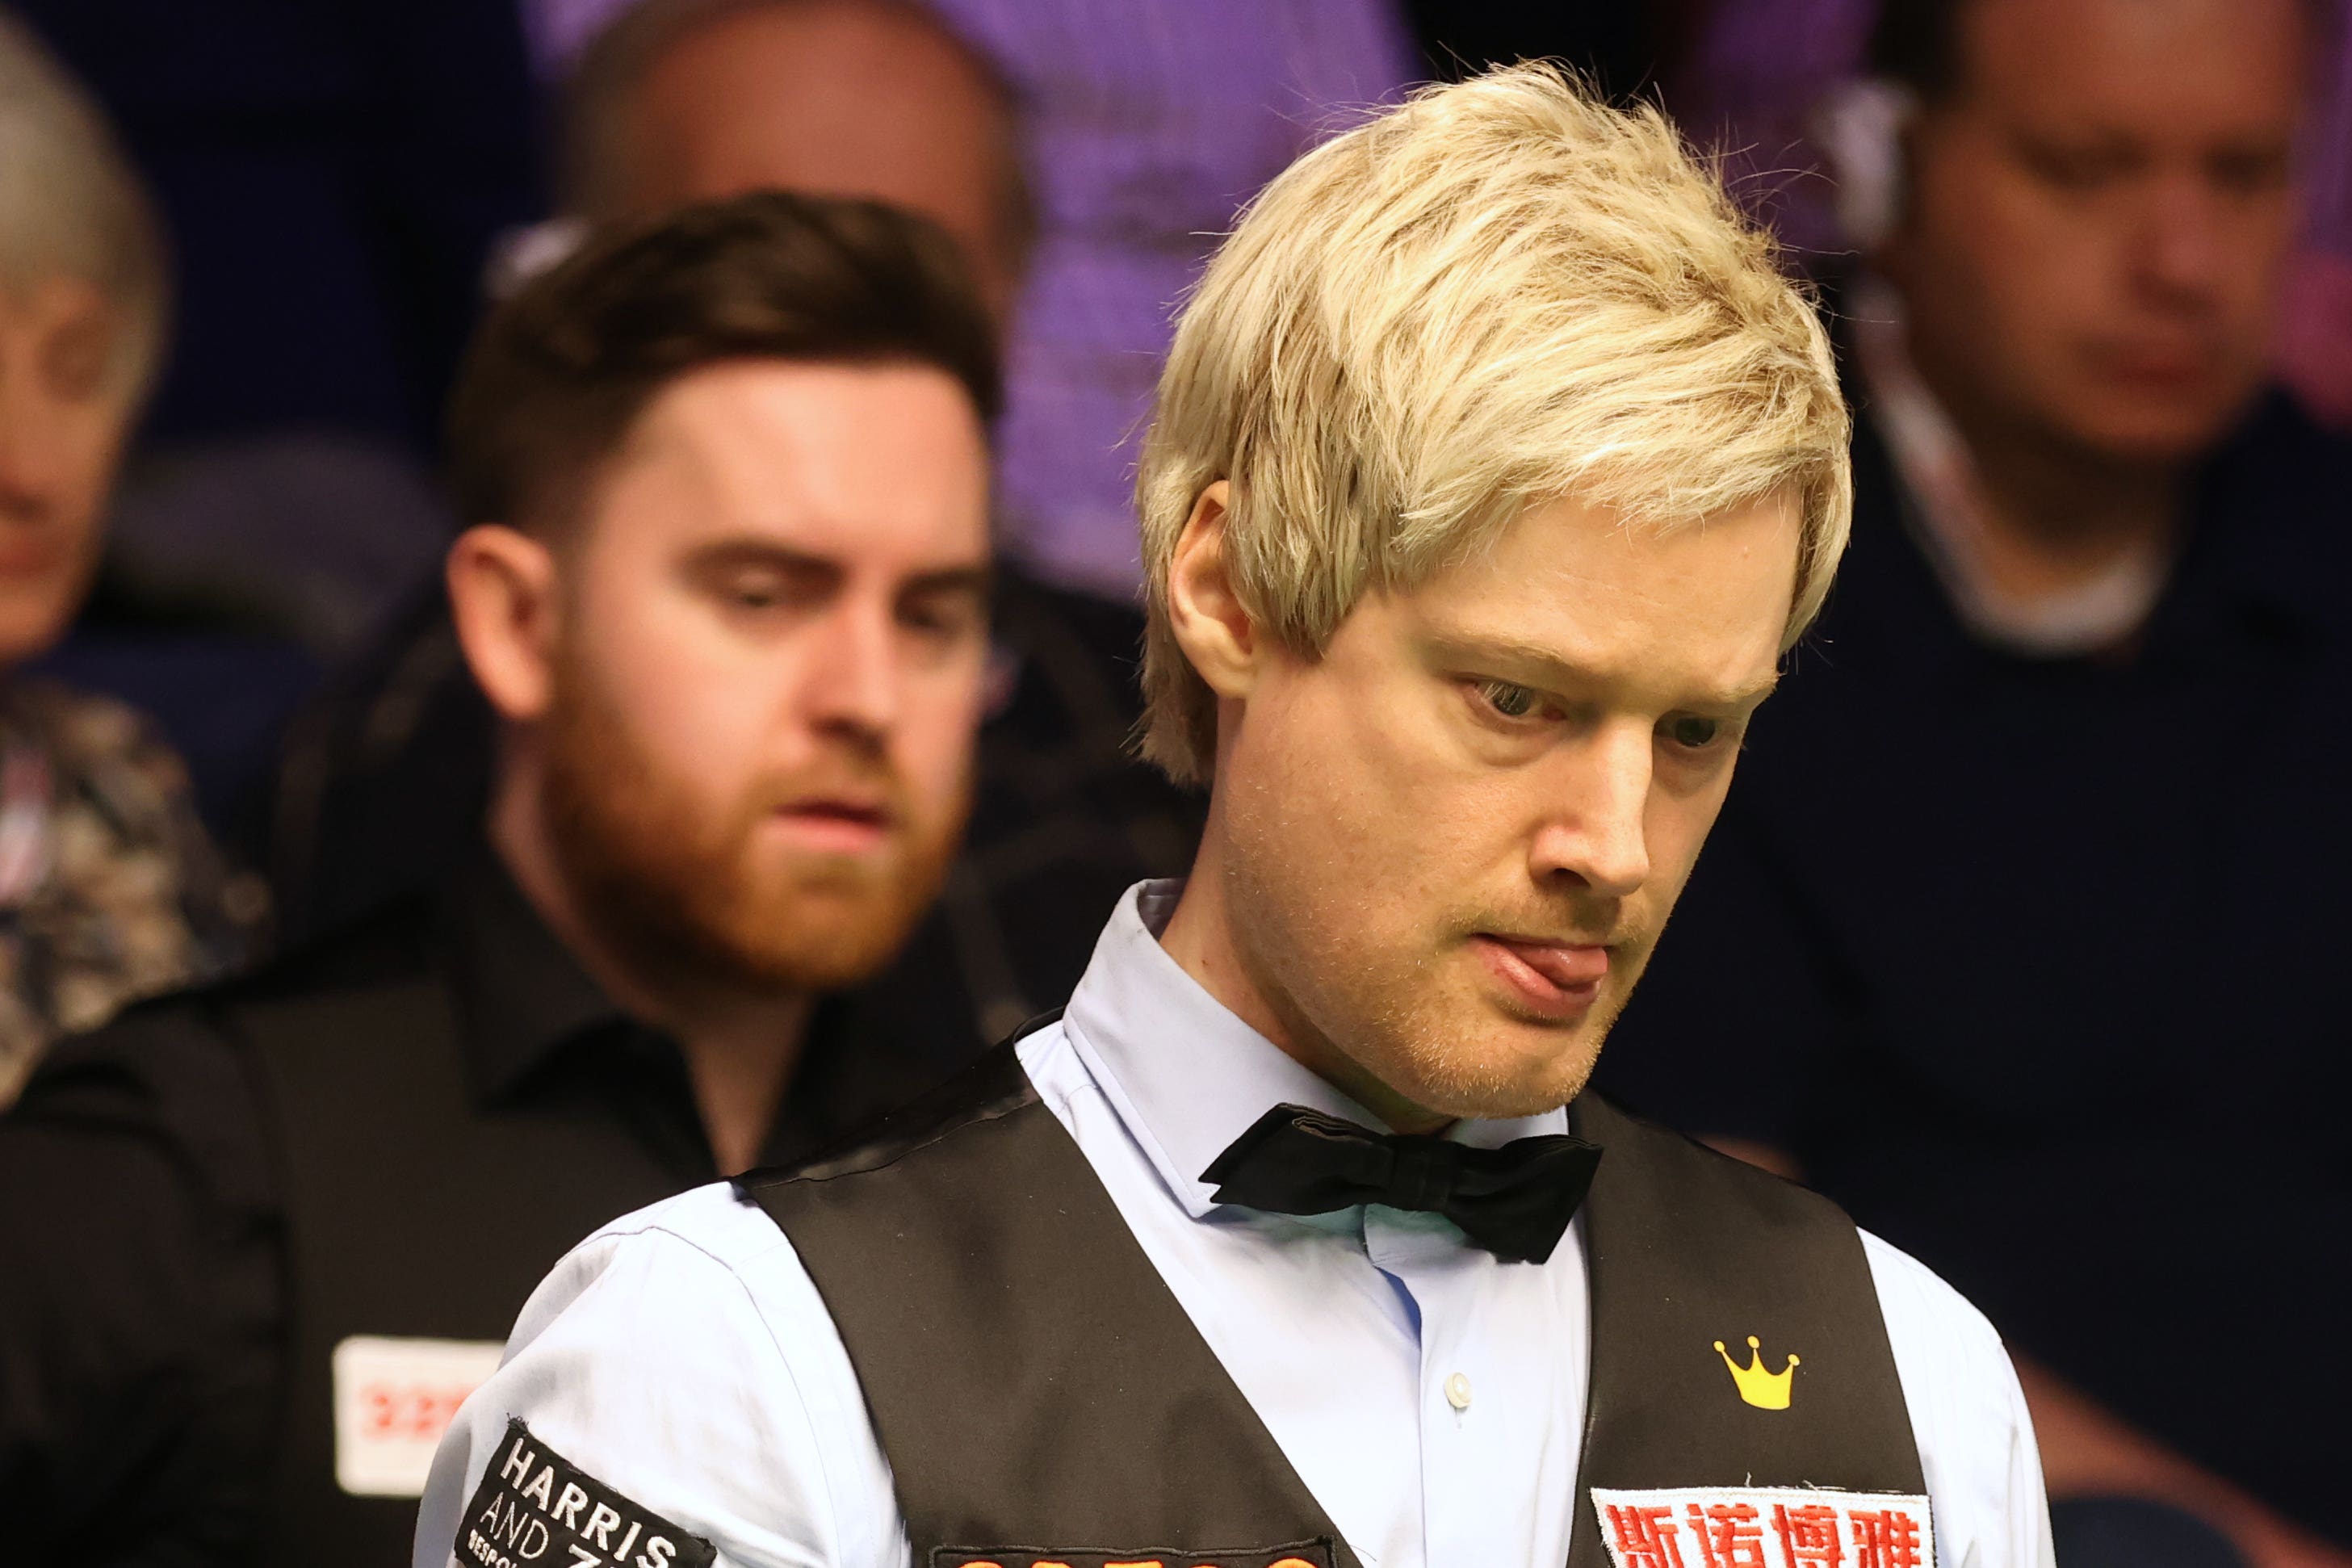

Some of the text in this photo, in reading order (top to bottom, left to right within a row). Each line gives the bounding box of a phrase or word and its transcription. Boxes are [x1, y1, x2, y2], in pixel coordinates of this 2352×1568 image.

[480, 1492, 549, 1560] AND
[500, 1437, 677, 1568] HARRIS
[1606, 1503, 1922, 1568] 斯诺博雅
